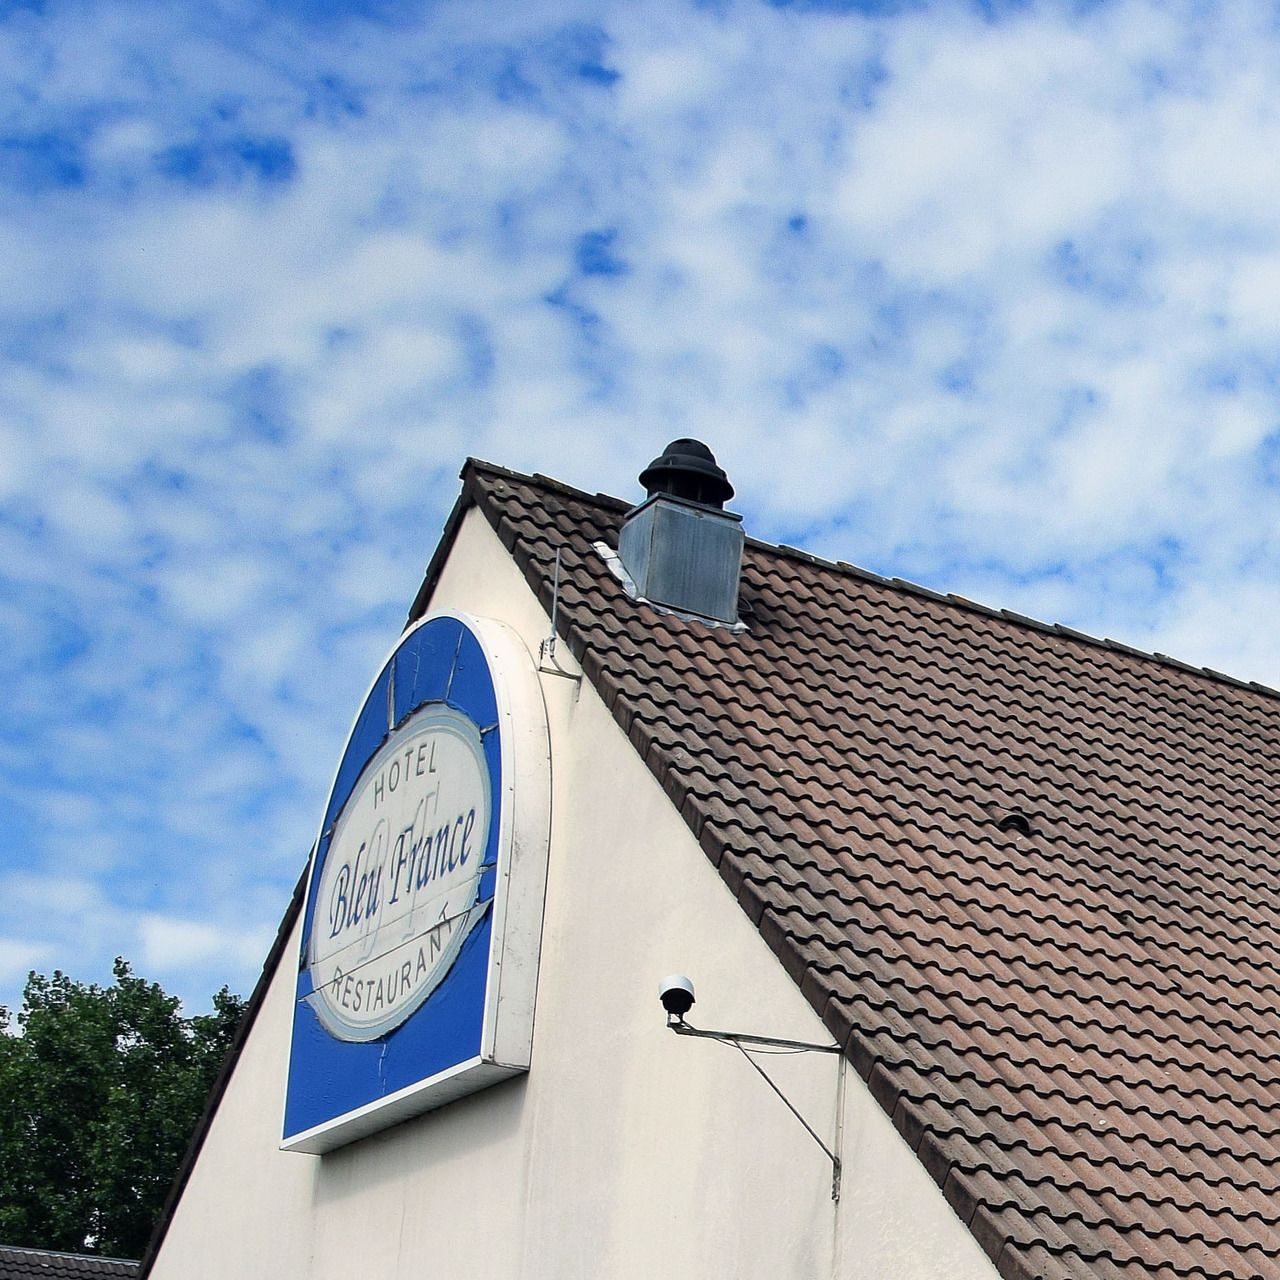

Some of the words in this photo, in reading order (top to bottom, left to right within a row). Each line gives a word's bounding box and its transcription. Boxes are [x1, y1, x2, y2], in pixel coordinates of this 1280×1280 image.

[373, 740, 437, 810] HOTEL
[328, 841, 383, 940] Bleu
[387, 807, 476, 905] France
[331, 901, 452, 1013] RESTAURANT
